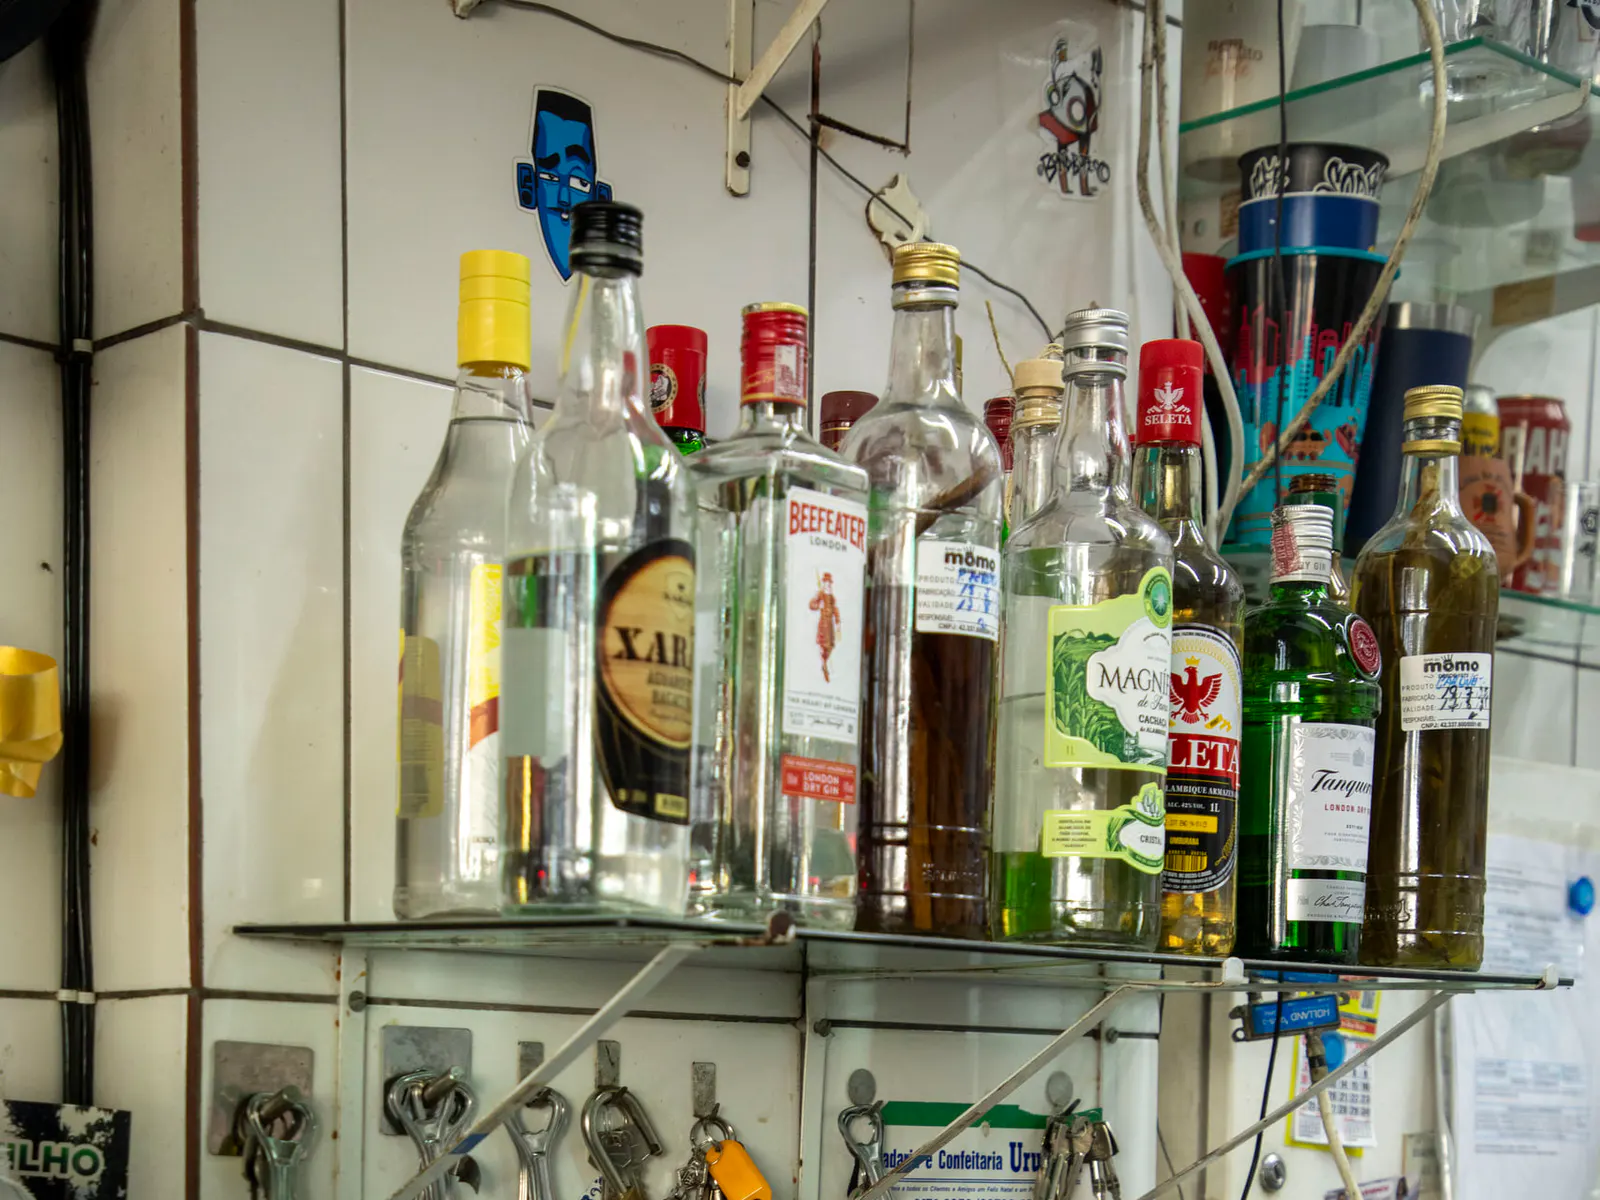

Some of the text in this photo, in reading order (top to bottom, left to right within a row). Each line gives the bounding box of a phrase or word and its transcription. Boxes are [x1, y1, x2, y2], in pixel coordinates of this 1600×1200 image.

[1144, 413, 1193, 426] SELETA
[789, 499, 866, 554] BEEFEATER
[809, 535, 848, 552] LONDON
[613, 625, 692, 670] XAR
[1209, 803, 1221, 813] 1L
[1324, 803, 1355, 812] LONDON
[1290, 1008, 1331, 1021] HOLLAND
[938, 1149, 1003, 1170] Confeitaria
